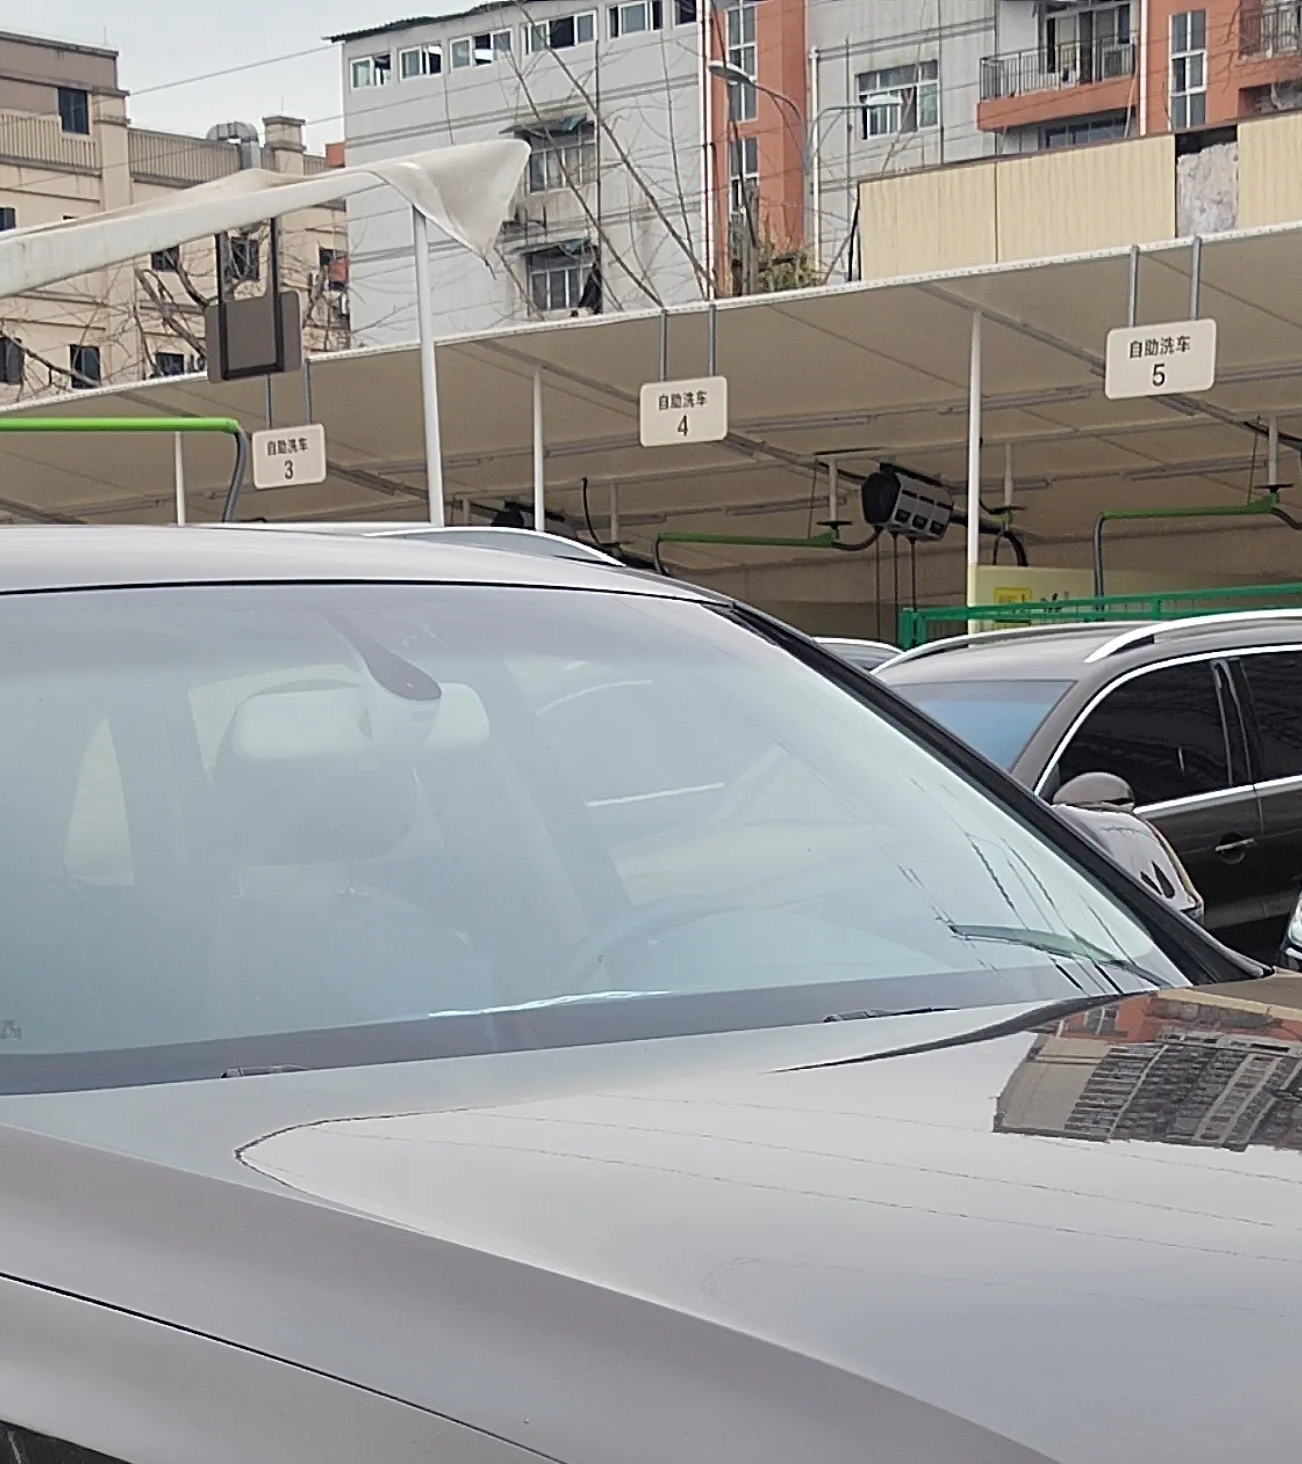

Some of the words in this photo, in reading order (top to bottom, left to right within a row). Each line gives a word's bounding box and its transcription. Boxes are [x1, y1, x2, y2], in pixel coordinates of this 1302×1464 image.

[1129, 335, 1191, 359] 自助洗车
[1152, 363, 1166, 387] 5
[658, 390, 708, 412] 自助洗车
[677, 414, 689, 437] 4
[284, 460, 294, 480] 3
